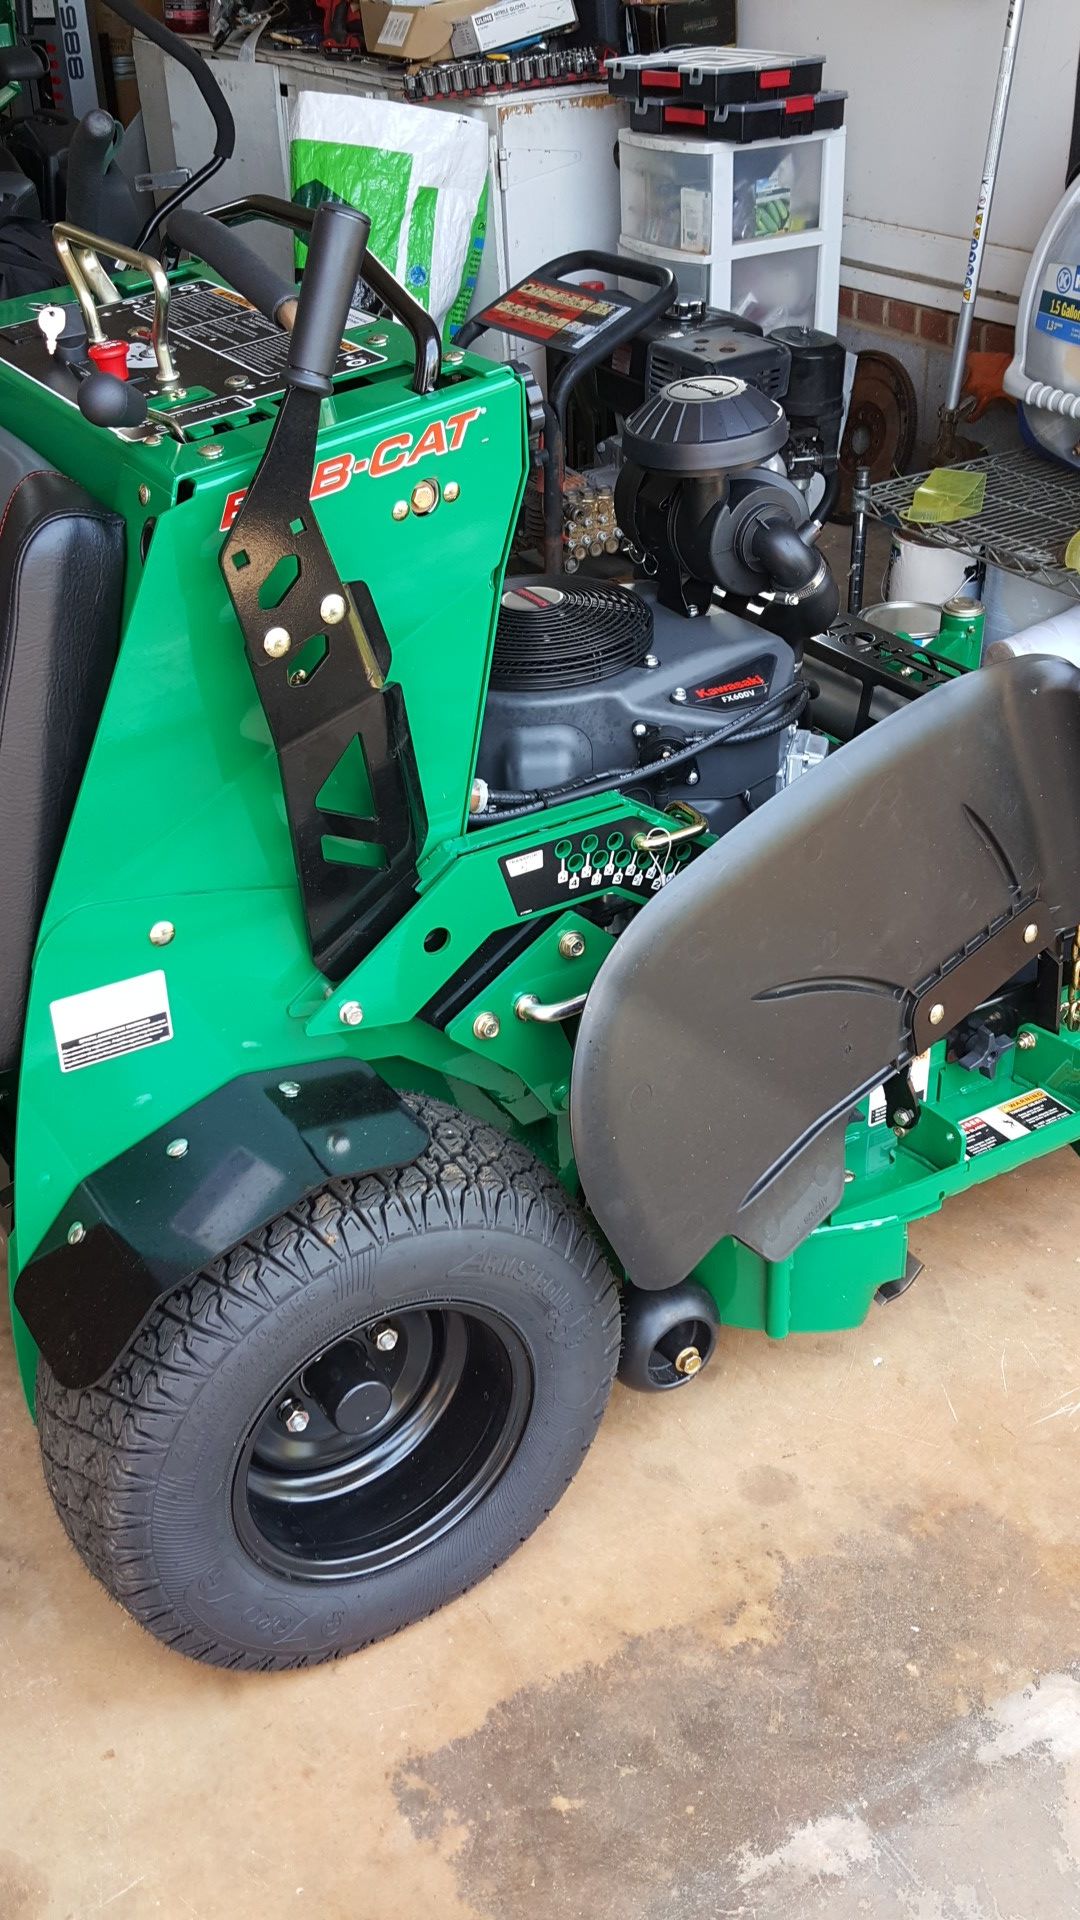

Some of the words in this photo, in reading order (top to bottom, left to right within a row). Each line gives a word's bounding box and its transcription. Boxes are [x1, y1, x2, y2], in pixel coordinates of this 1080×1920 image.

[475, 13, 494, 26] ULINE
[695, 674, 765, 699] Kawasaki
[721, 689, 755, 703] FX600V
